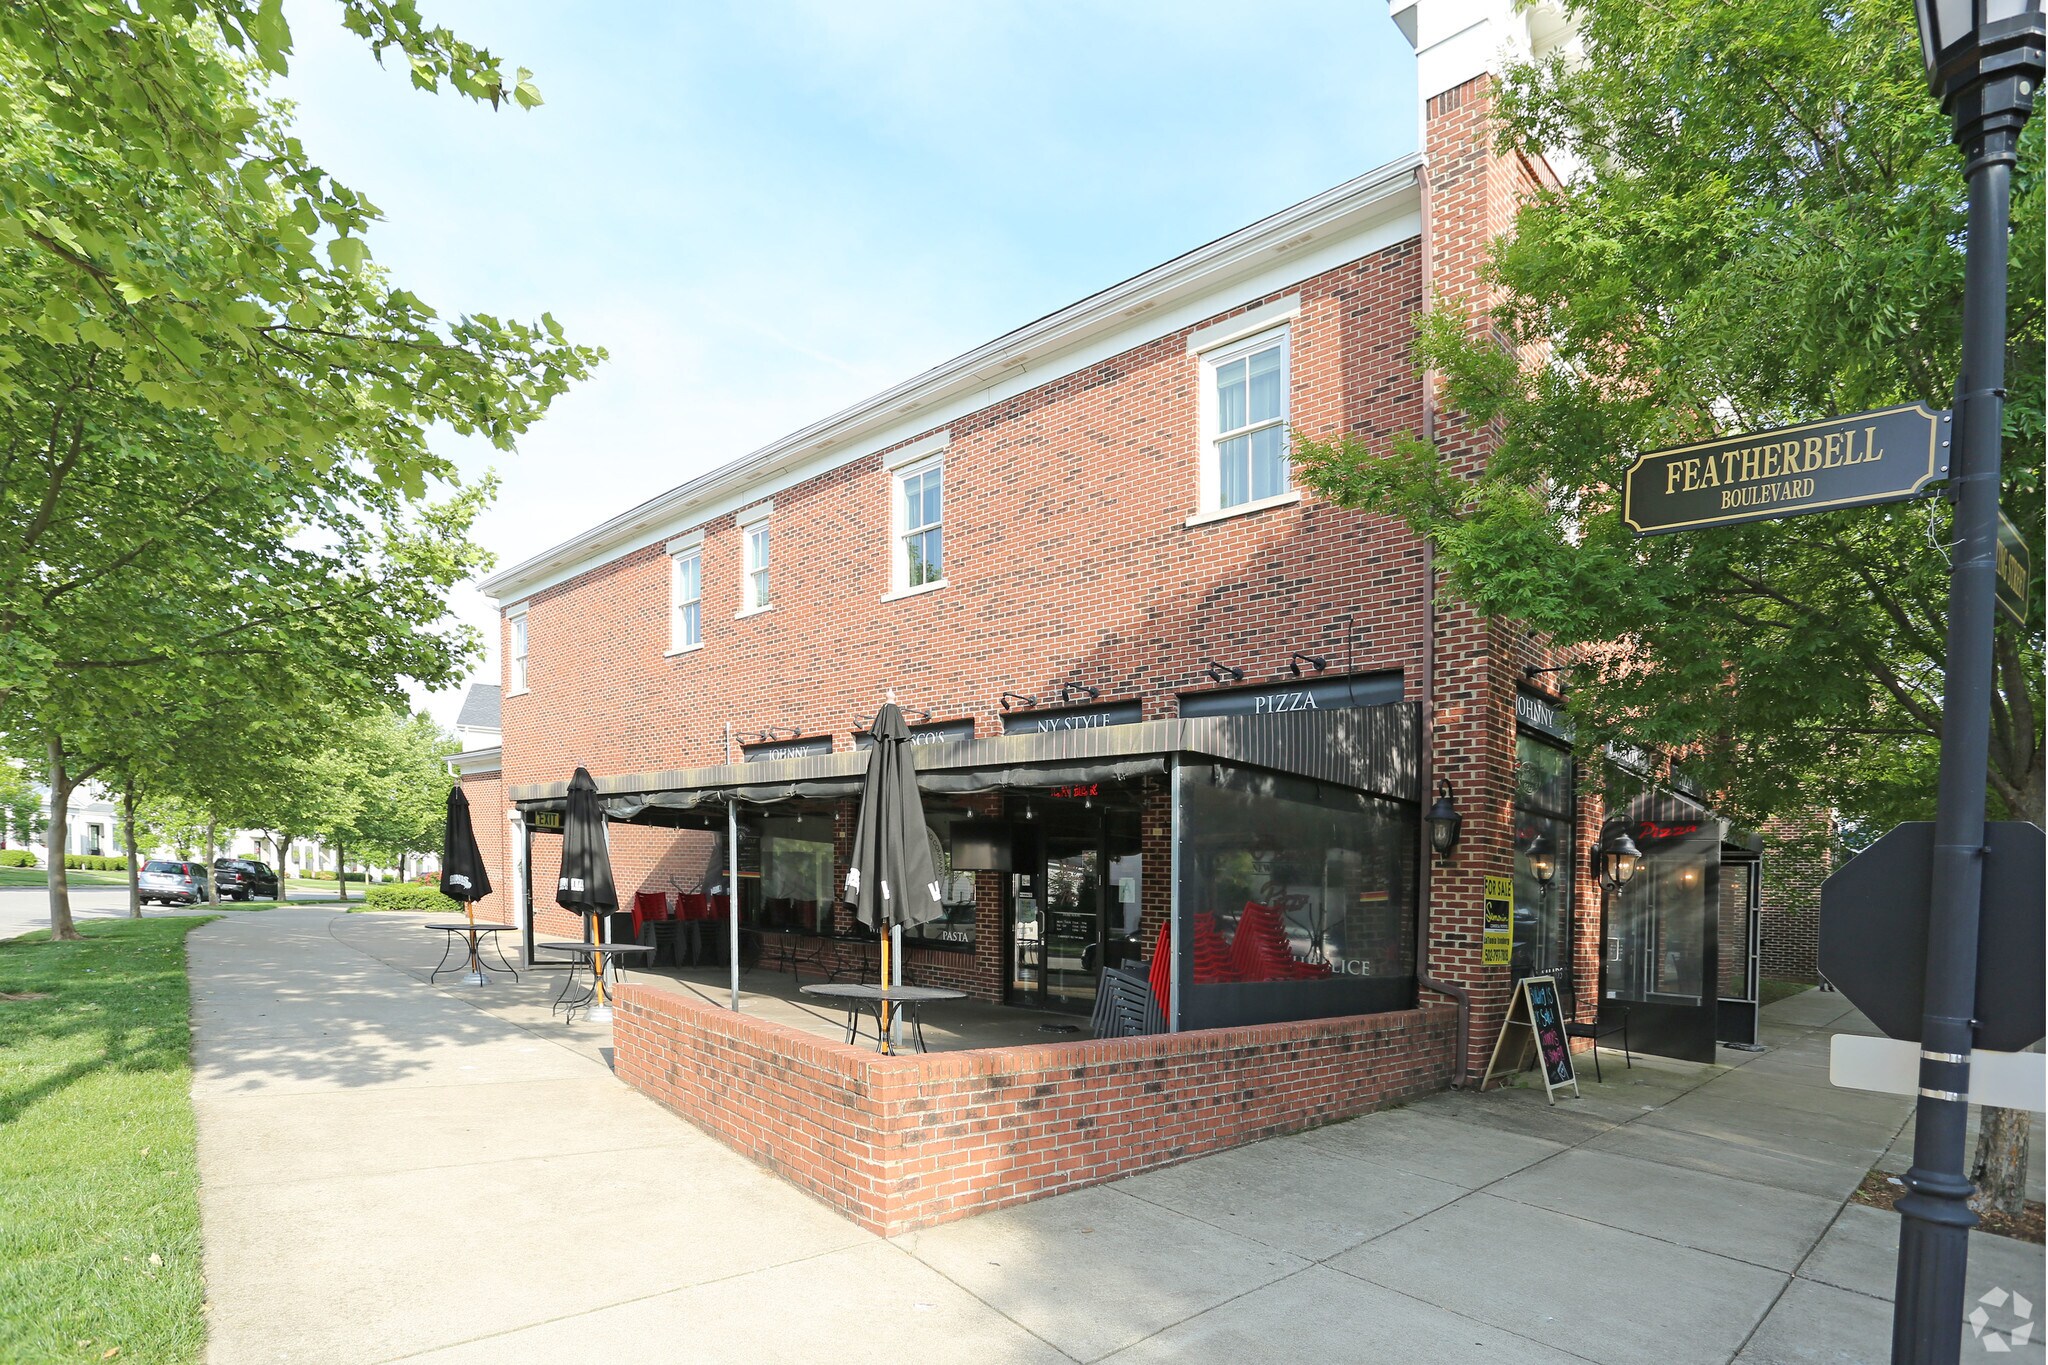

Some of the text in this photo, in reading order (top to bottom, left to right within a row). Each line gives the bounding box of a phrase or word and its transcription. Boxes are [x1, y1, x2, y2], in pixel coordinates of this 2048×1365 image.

[1665, 426, 1884, 495] FEATHERBELL
[1720, 477, 1815, 510] BOULEVARD
[1254, 690, 1319, 715] PIZZA
[1037, 718, 1060, 733] NY
[539, 813, 558, 826] EXIT
[1637, 821, 1698, 839] Pizza
[1484, 879, 1512, 897] FOR SALE
[942, 929, 969, 944] PASTA
[1331, 959, 1371, 976] LICE
